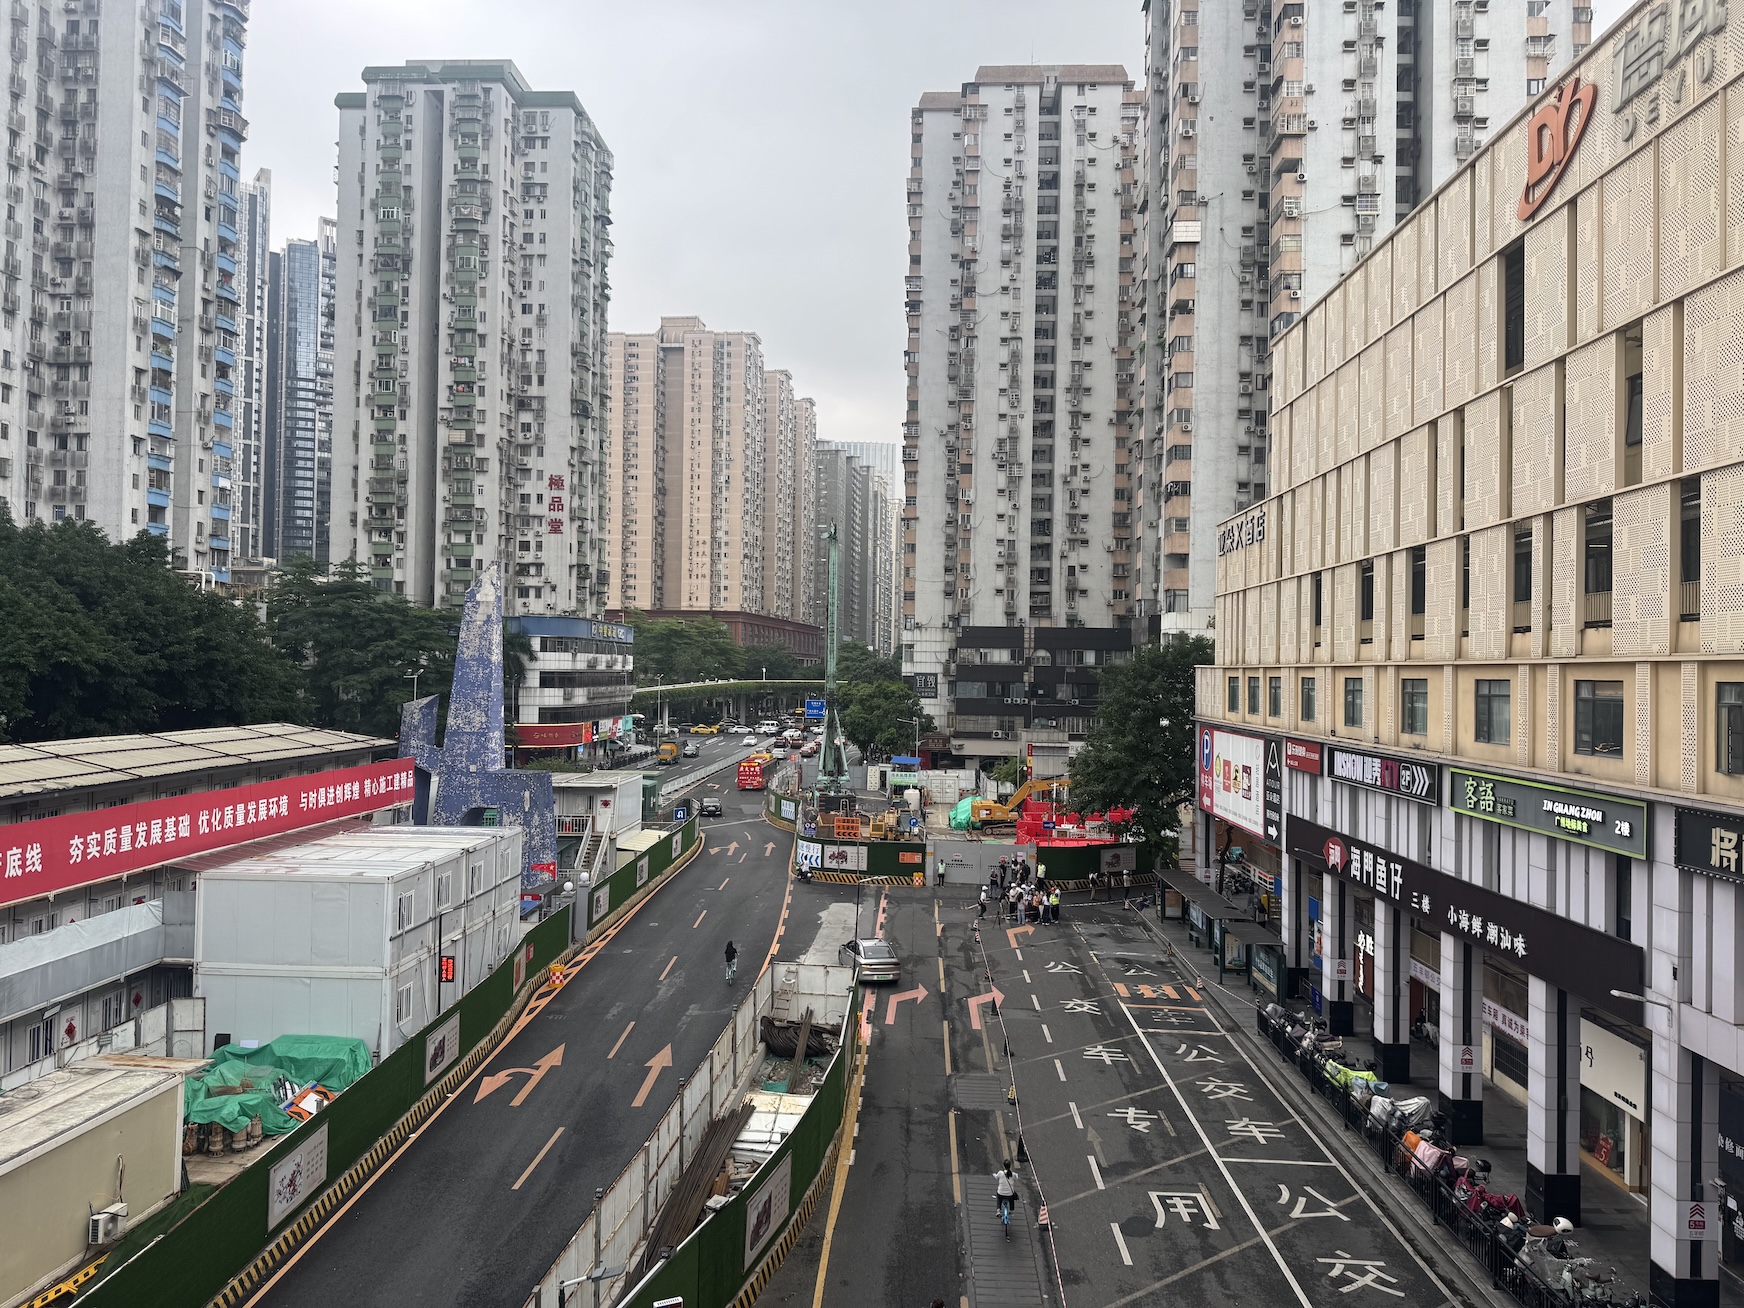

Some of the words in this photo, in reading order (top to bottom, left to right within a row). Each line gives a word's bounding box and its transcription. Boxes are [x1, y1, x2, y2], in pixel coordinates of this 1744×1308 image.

[548, 474, 565, 535] 極品堂
[1401, 769, 1411, 788] 2F
[0, 842, 43, 879] 底线
[68, 812, 191, 865] 夯实质量发展基础
[197, 794, 289, 835] 优化质量发展环境
[299, 780, 361, 812] 与时俱进创辉煌
[363, 769, 415, 798] 精心施工建精品
[798, 840, 820, 854] 速慢行
[1614, 819, 1632, 838] 2楼
[1710, 827, 1744, 875] 將
[1350, 845, 1403, 901] 海門鱼仔
[1410, 891, 1432, 915] 三楼
[1447, 904, 1484, 939] 小海鲜
[1485, 920, 1529, 960] 潮汕味
